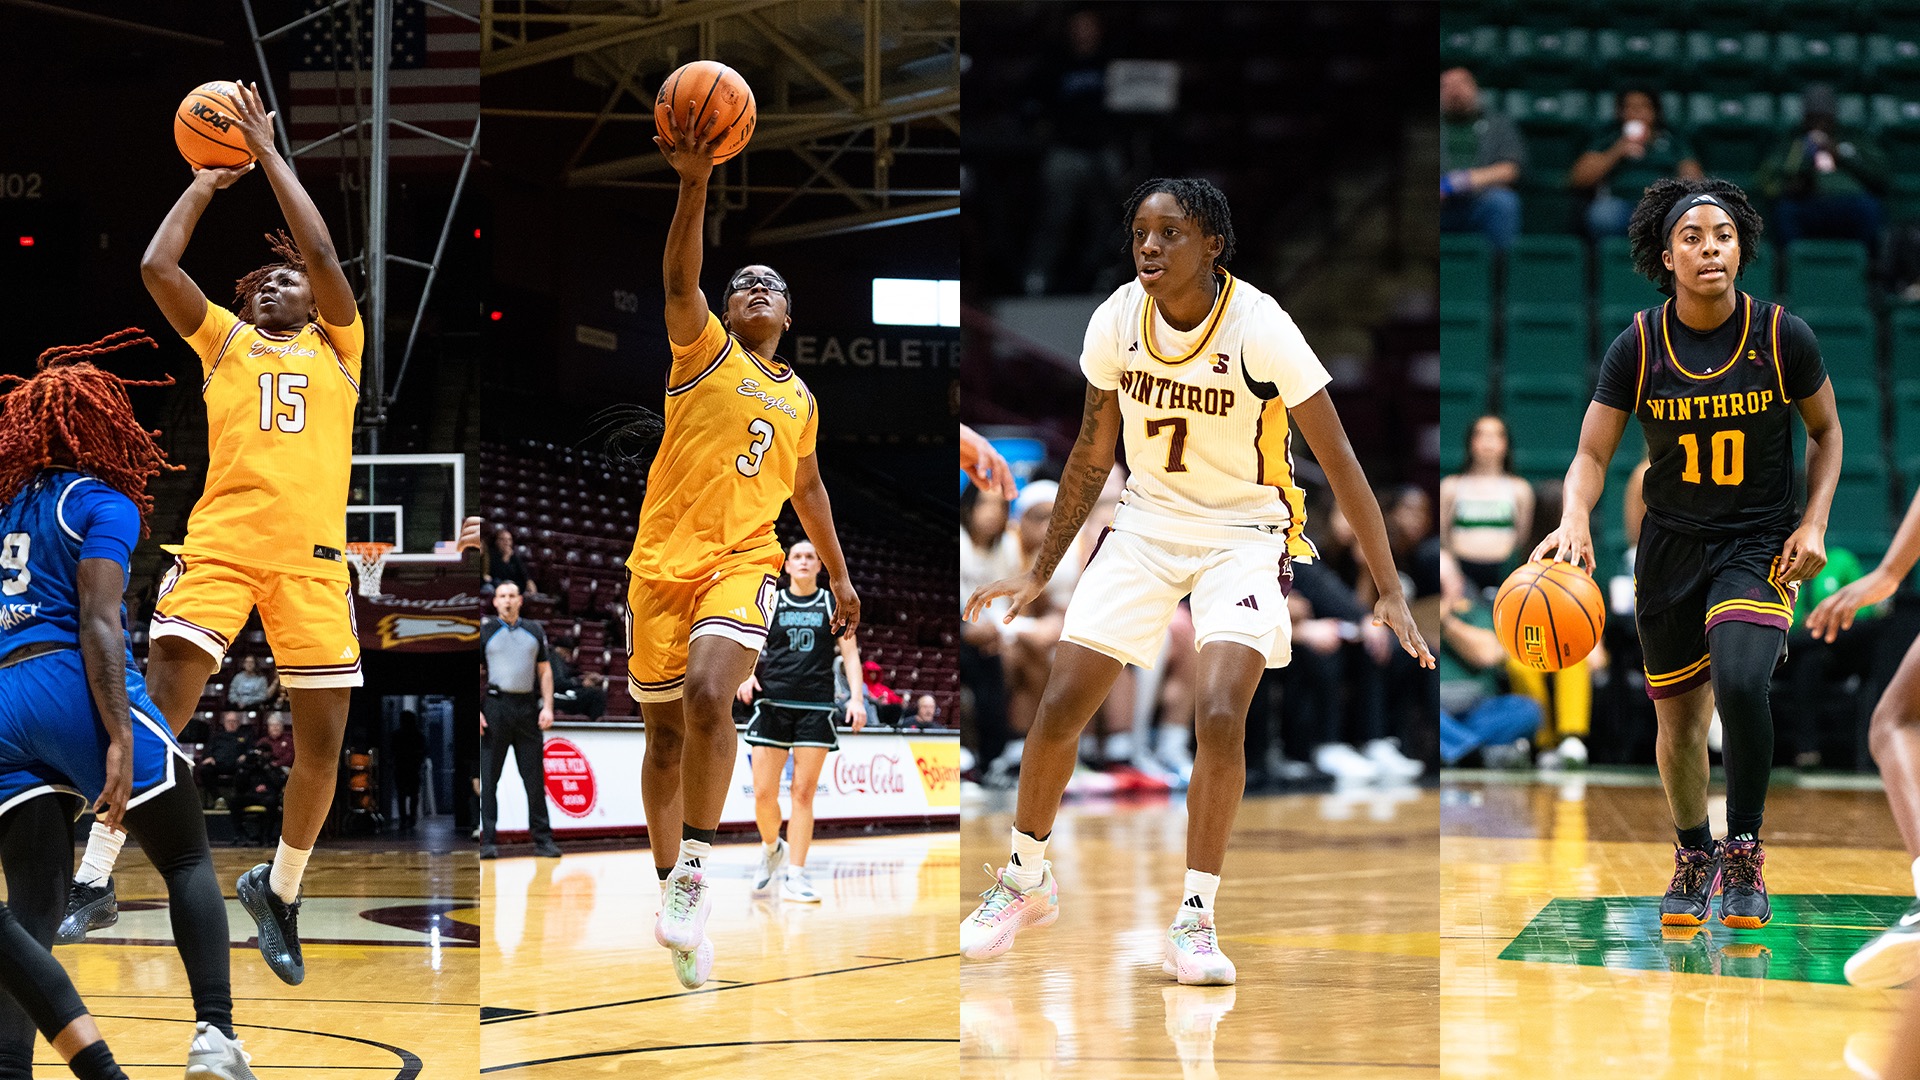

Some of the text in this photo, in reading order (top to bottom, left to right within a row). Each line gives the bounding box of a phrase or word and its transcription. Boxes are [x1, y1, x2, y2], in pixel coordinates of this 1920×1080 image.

[189, 102, 231, 133] NCAA
[247, 340, 318, 359] Eagles
[258, 372, 309, 434] 15
[736, 378, 797, 419] Eagles
[1119, 370, 1235, 417] WINTHROP
[1646, 389, 1773, 421] WINTHROP
[736, 418, 774, 478] 3
[1144, 417, 1190, 473] 7
[1678, 429, 1745, 486] 10
[778, 611, 824, 627] UNCW
[786, 628, 815, 652] 10
